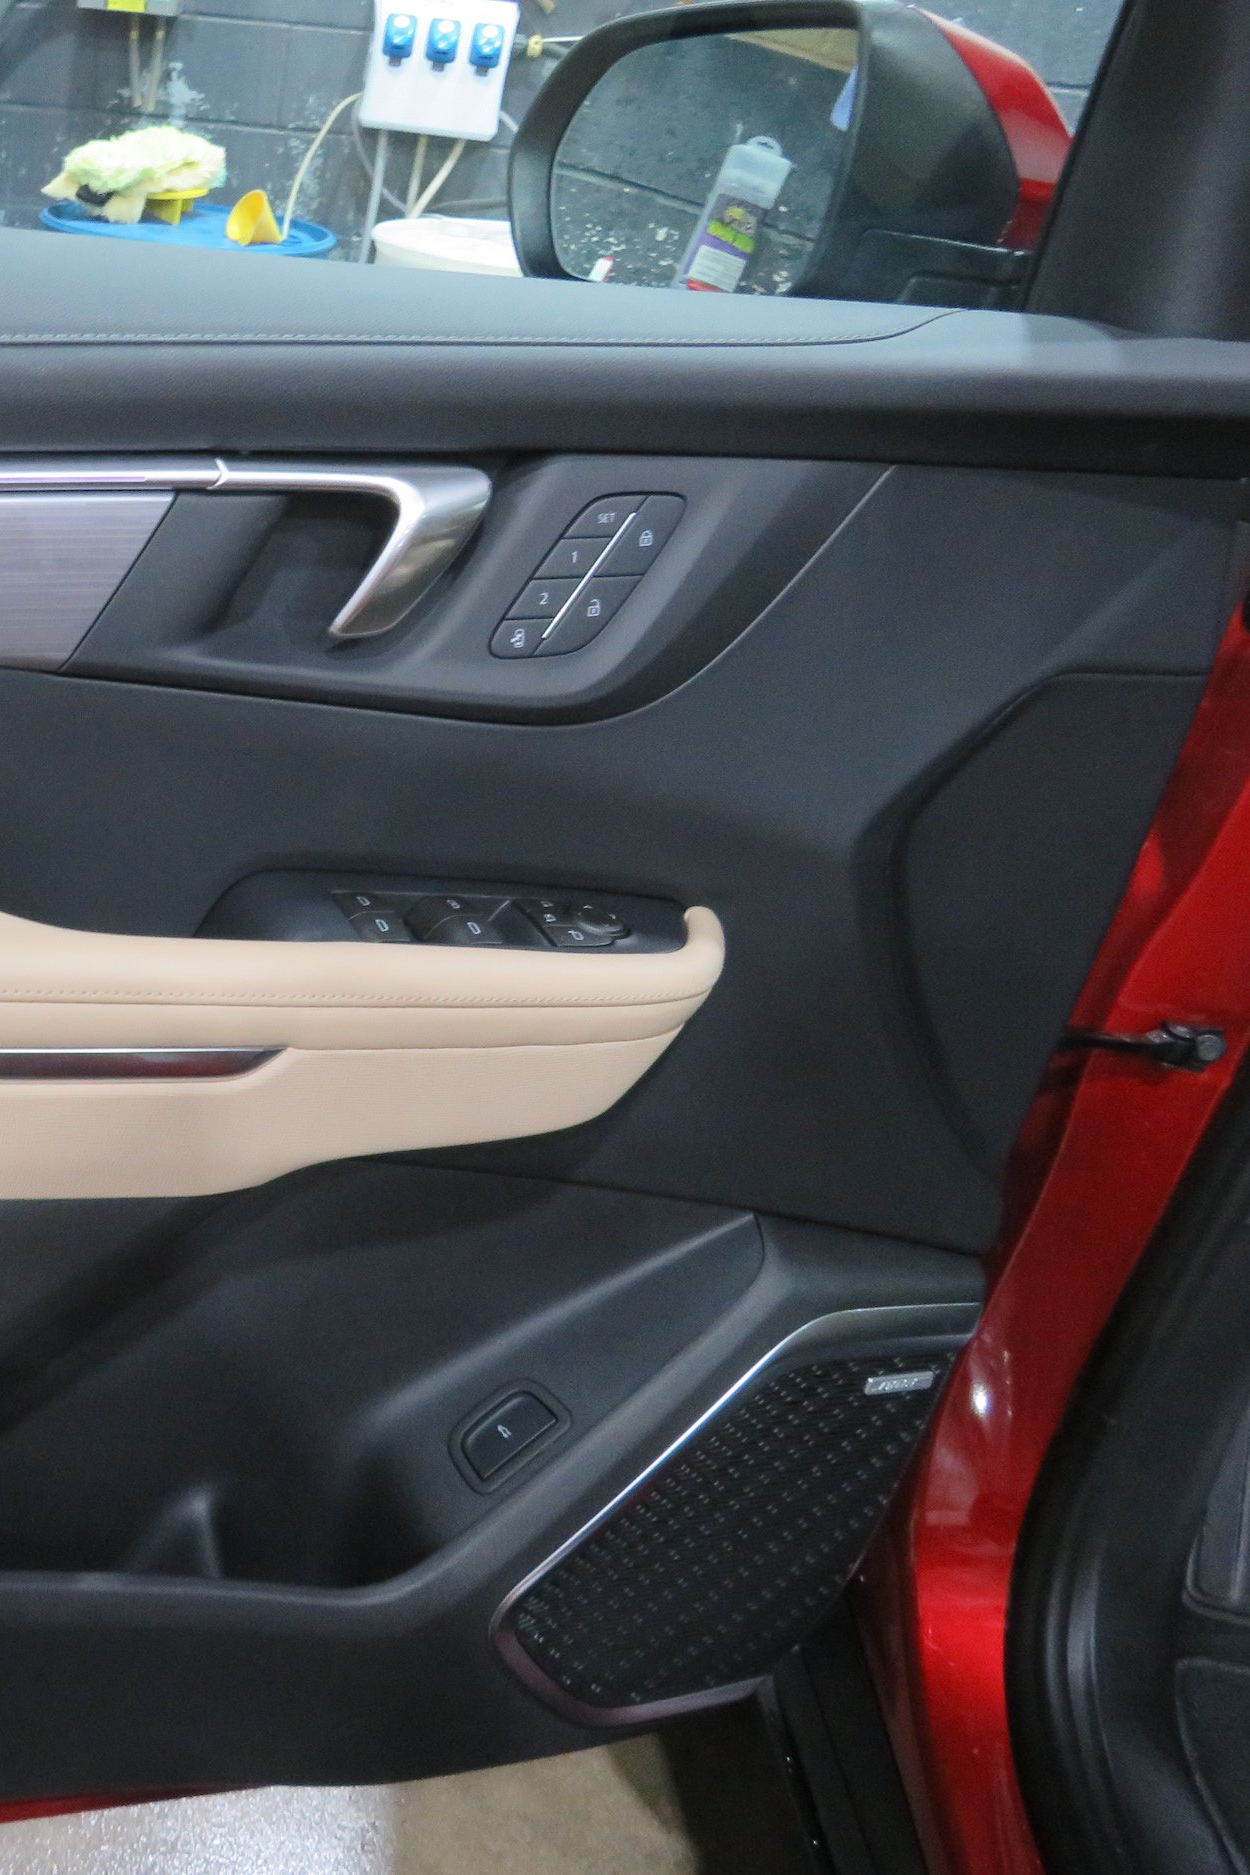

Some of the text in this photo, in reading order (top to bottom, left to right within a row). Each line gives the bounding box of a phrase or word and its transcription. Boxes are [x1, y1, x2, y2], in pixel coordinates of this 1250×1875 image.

[598, 513, 616, 524] SET
[571, 551, 579, 563] 1
[540, 592, 549, 604] 2
